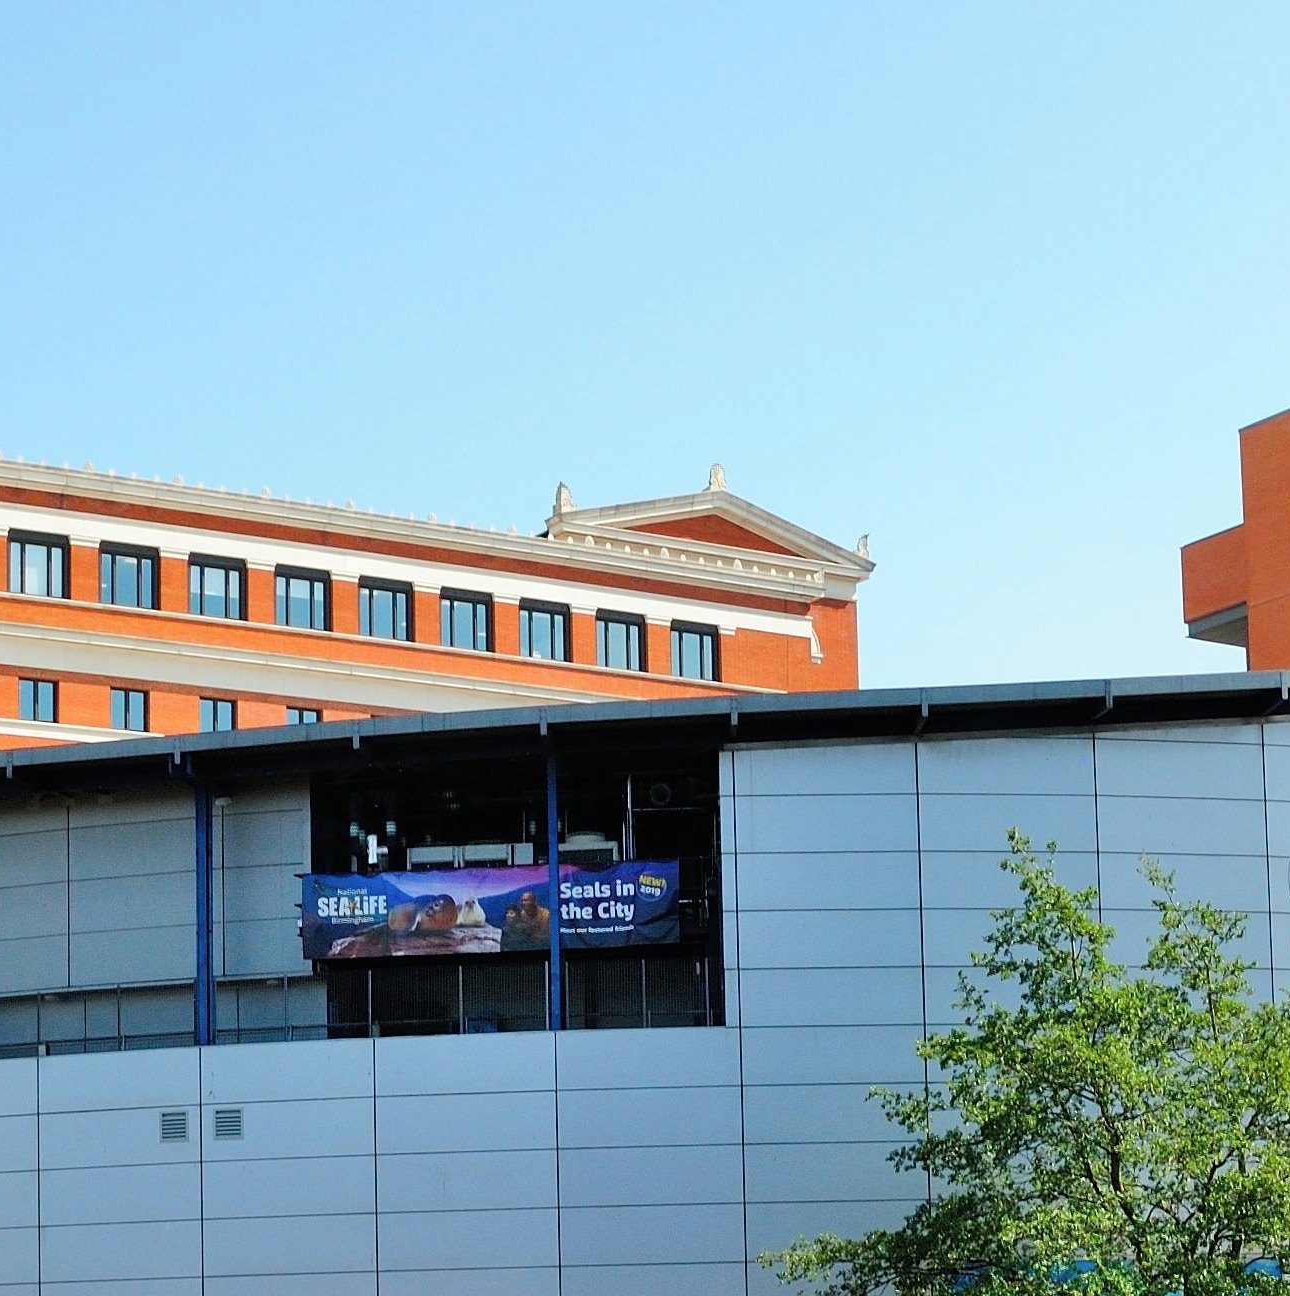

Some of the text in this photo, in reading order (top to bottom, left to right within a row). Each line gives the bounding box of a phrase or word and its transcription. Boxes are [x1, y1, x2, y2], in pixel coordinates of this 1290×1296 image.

[560, 879, 635, 899] Seals in
[560, 901, 635, 921] the City
